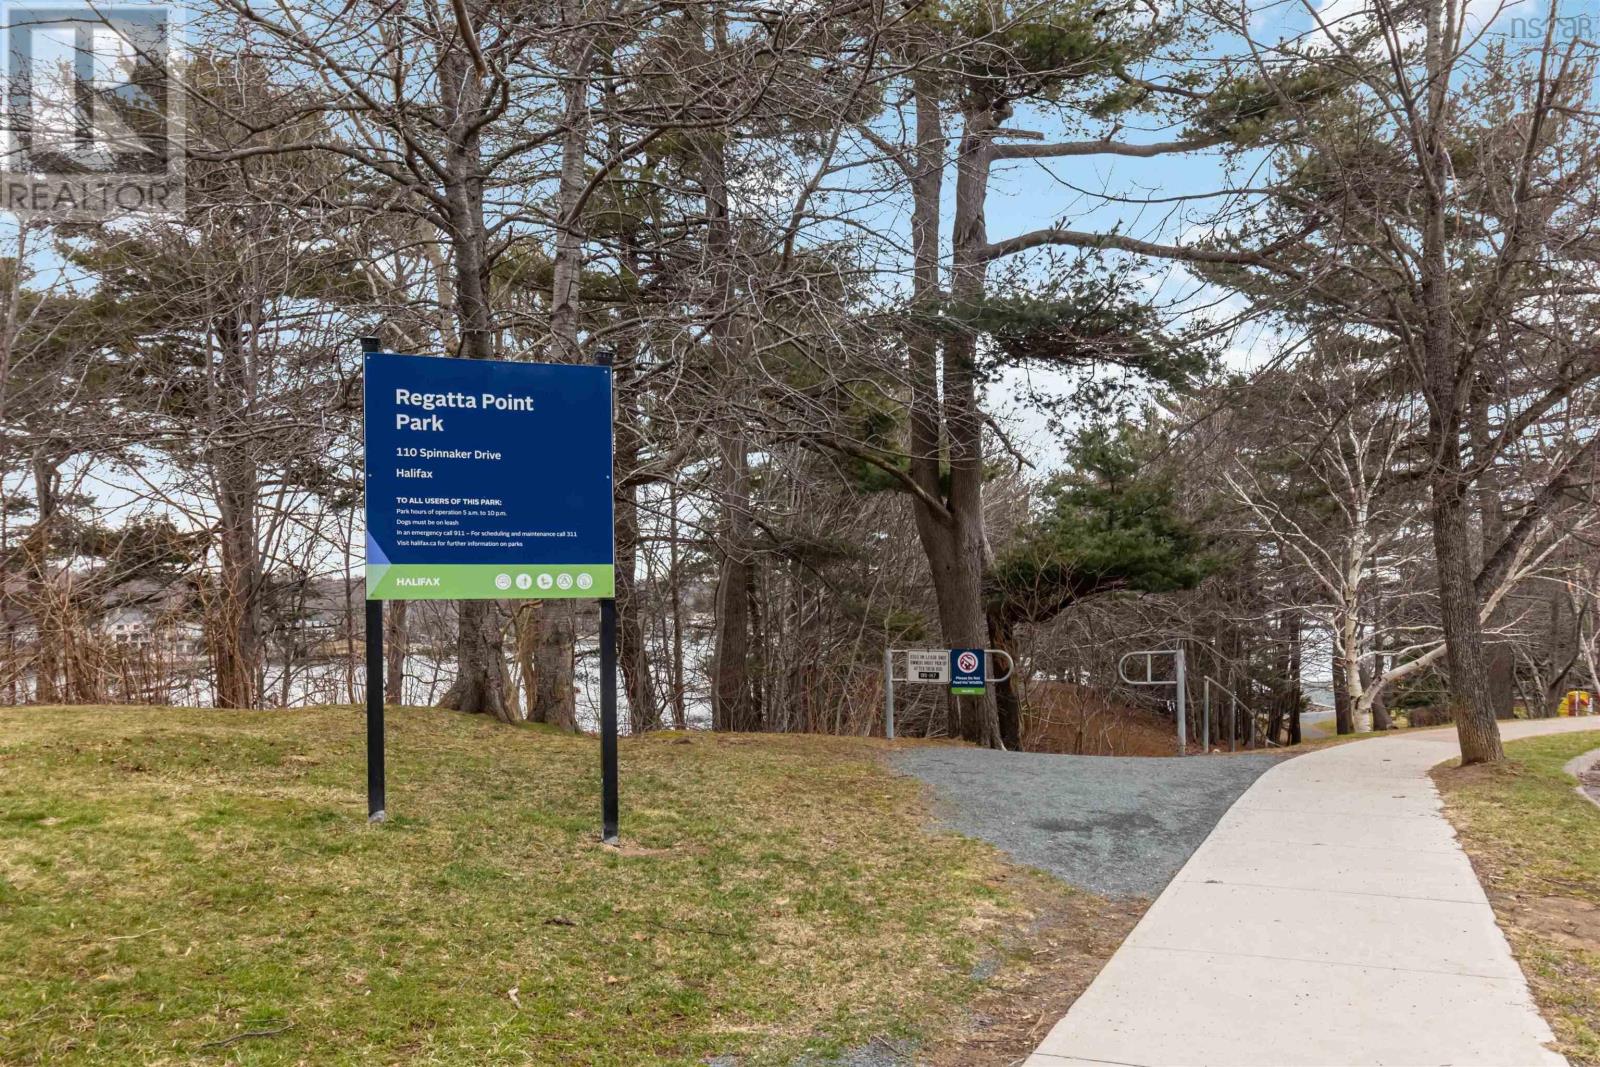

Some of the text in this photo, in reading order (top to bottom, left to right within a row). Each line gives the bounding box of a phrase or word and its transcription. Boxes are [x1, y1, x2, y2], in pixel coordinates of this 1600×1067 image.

[395, 388, 534, 411] Regatta Point
[396, 413, 444, 431] Park
[396, 447, 502, 460] 110 Spinnaker Drive
[396, 468, 433, 478] Halifax
[435, 509, 462, 517] operation
[481, 530, 510, 538] scheduling
[396, 577, 440, 586] HALIFAX
